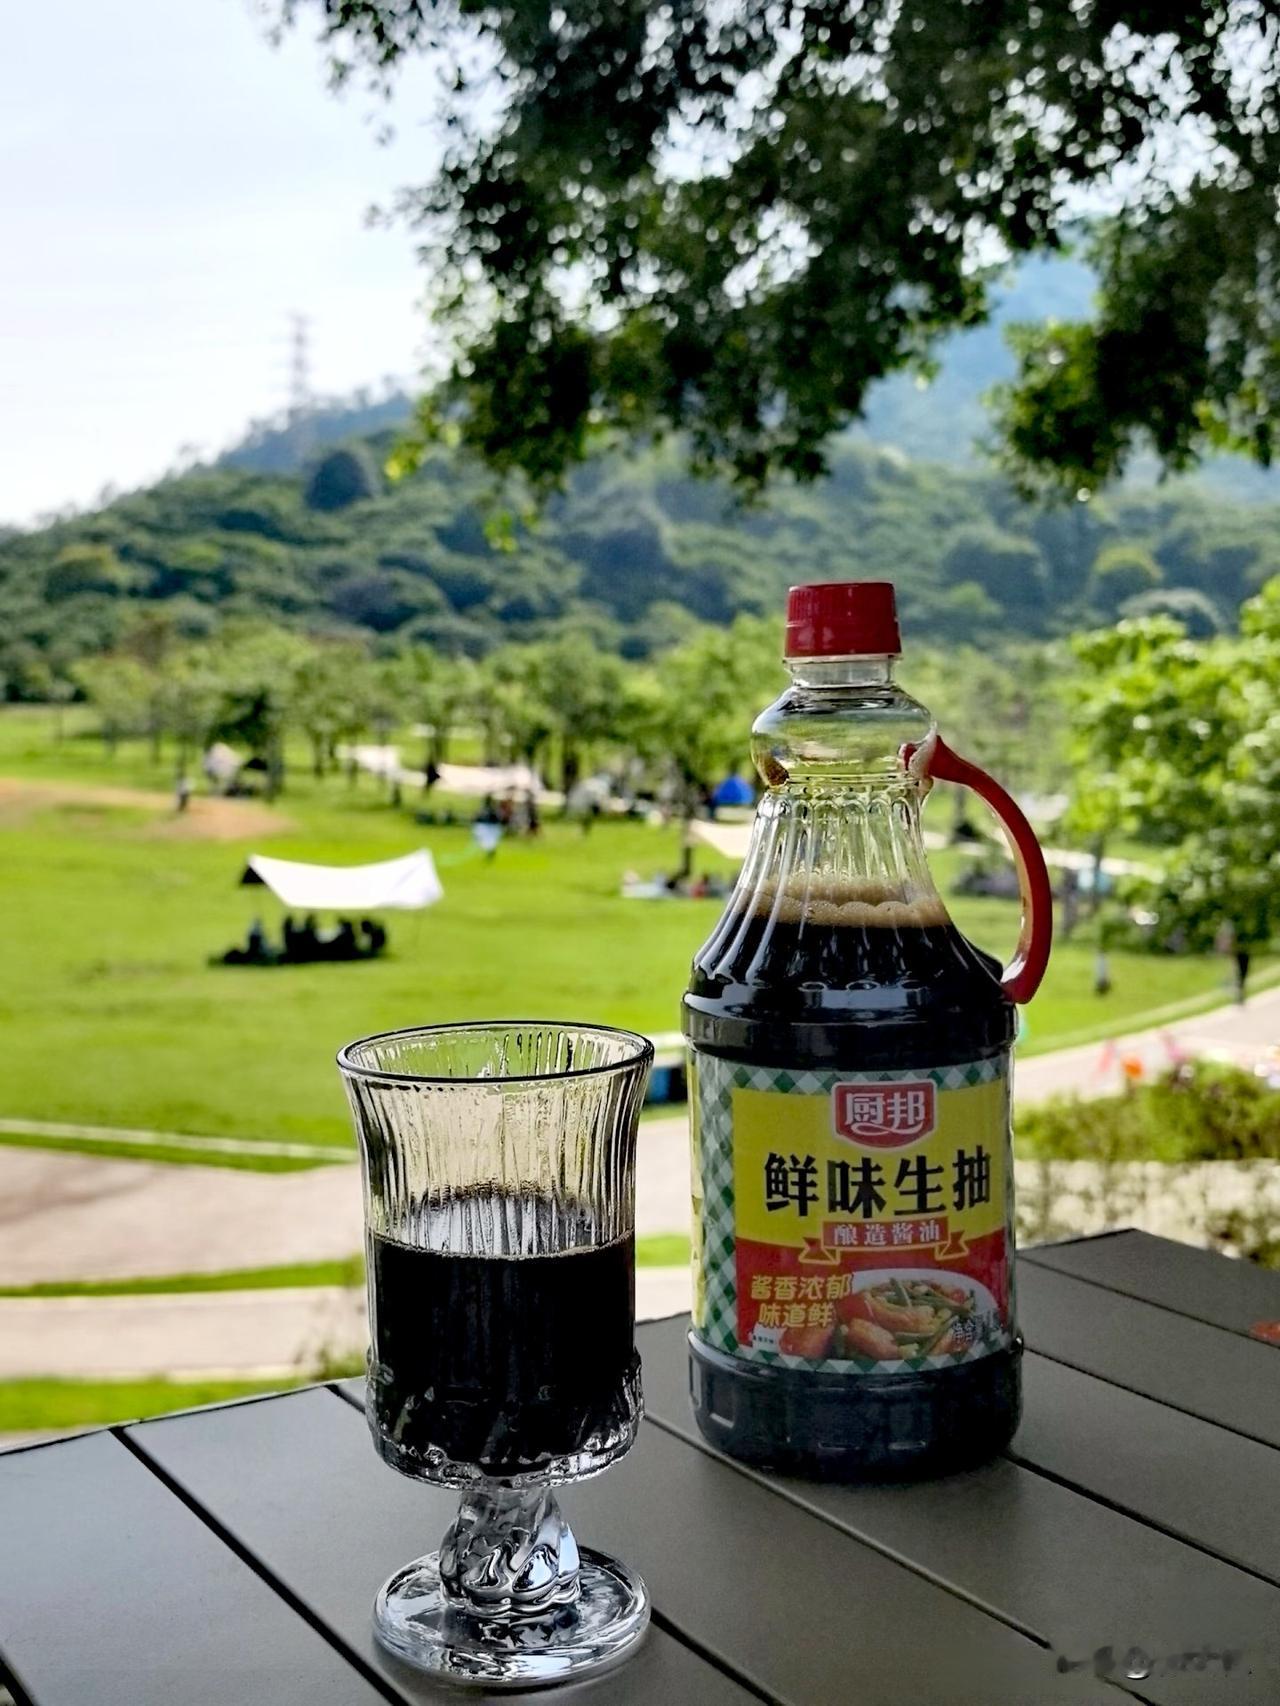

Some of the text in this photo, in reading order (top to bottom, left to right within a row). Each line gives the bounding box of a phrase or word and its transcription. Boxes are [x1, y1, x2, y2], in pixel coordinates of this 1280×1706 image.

[845, 1091, 927, 1135] 厨邦
[764, 1145, 992, 1218] 鲜味生抽
[834, 1220, 940, 1246] 酿造酱油
[751, 1274, 852, 1300] 酱香浓郁
[759, 1302, 834, 1328] 味道鲜
